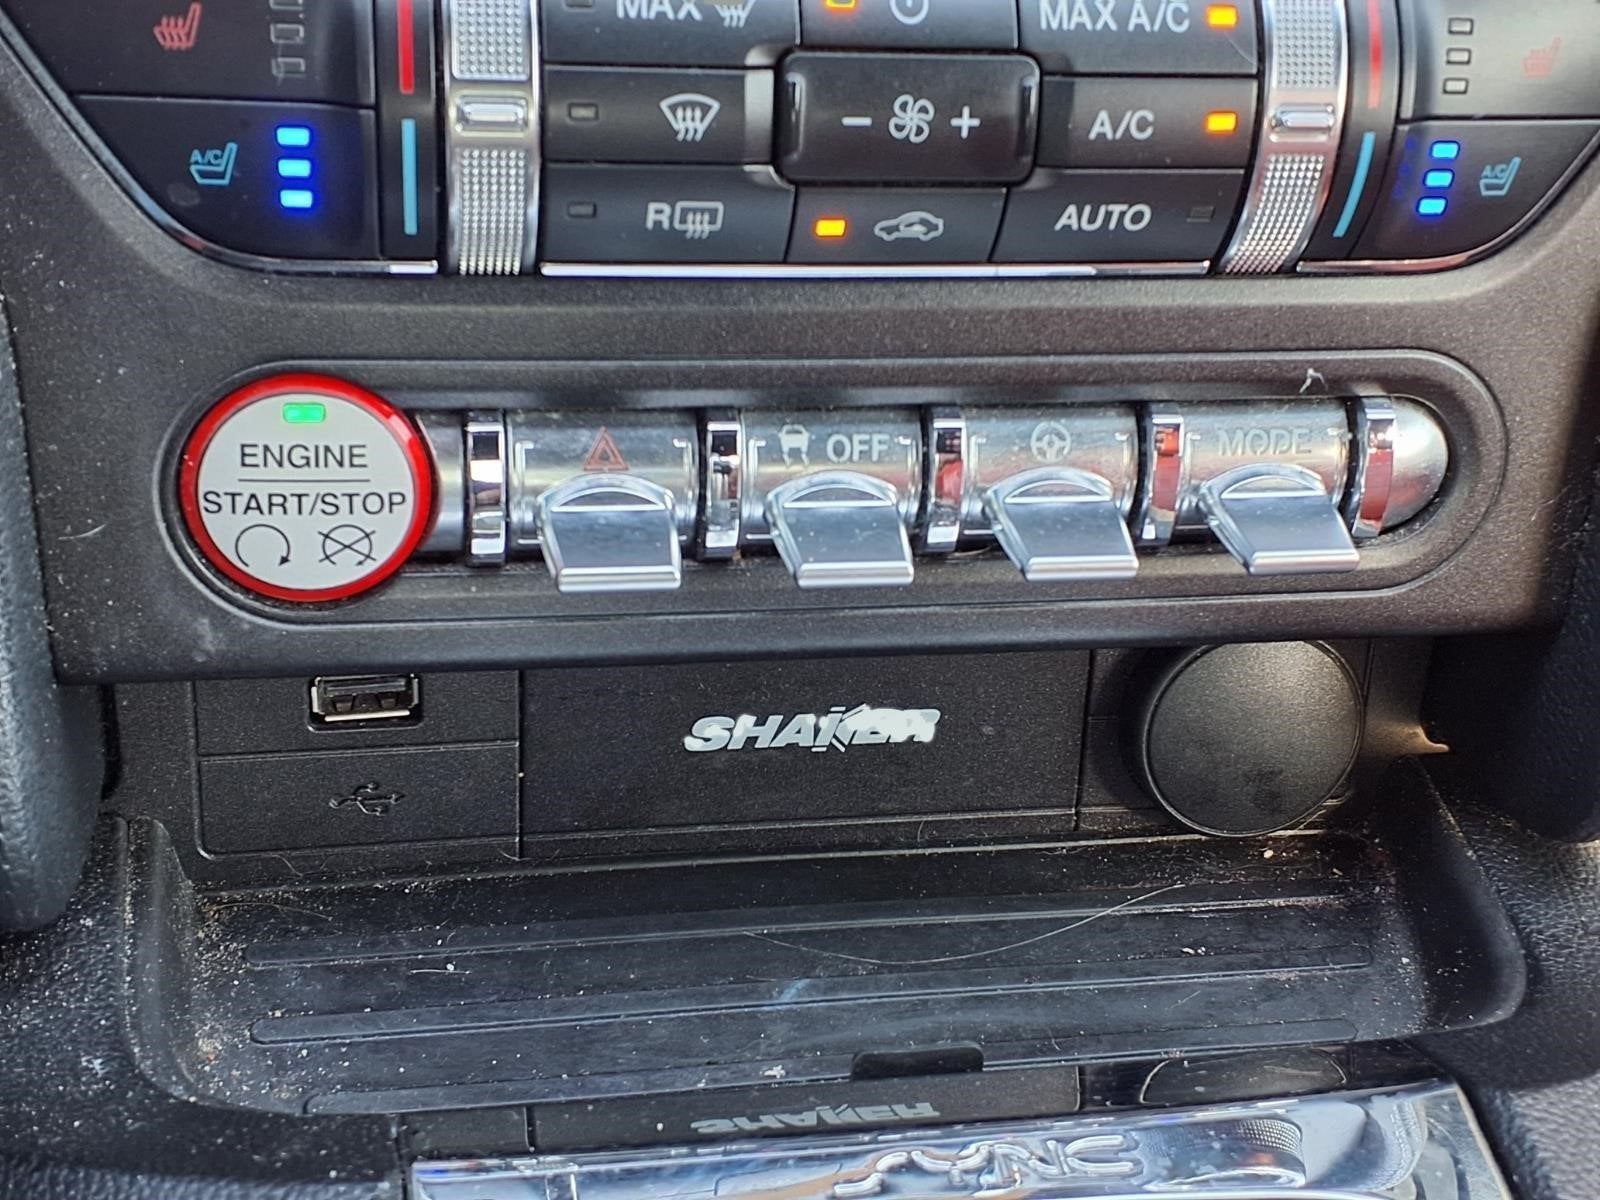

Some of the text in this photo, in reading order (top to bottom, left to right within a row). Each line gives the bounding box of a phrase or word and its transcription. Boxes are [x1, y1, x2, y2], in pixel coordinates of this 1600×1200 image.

[616, 0, 702, 20] MAX
[1038, 0, 1190, 33] MAX A/C
[1088, 109, 1154, 141] A/C
[1056, 203, 1151, 232] AUTO
[240, 443, 369, 469] ENGINE
[826, 433, 890, 462] OFF
[1218, 427, 1312, 457] MODE
[203, 491, 407, 518] START/STOP
